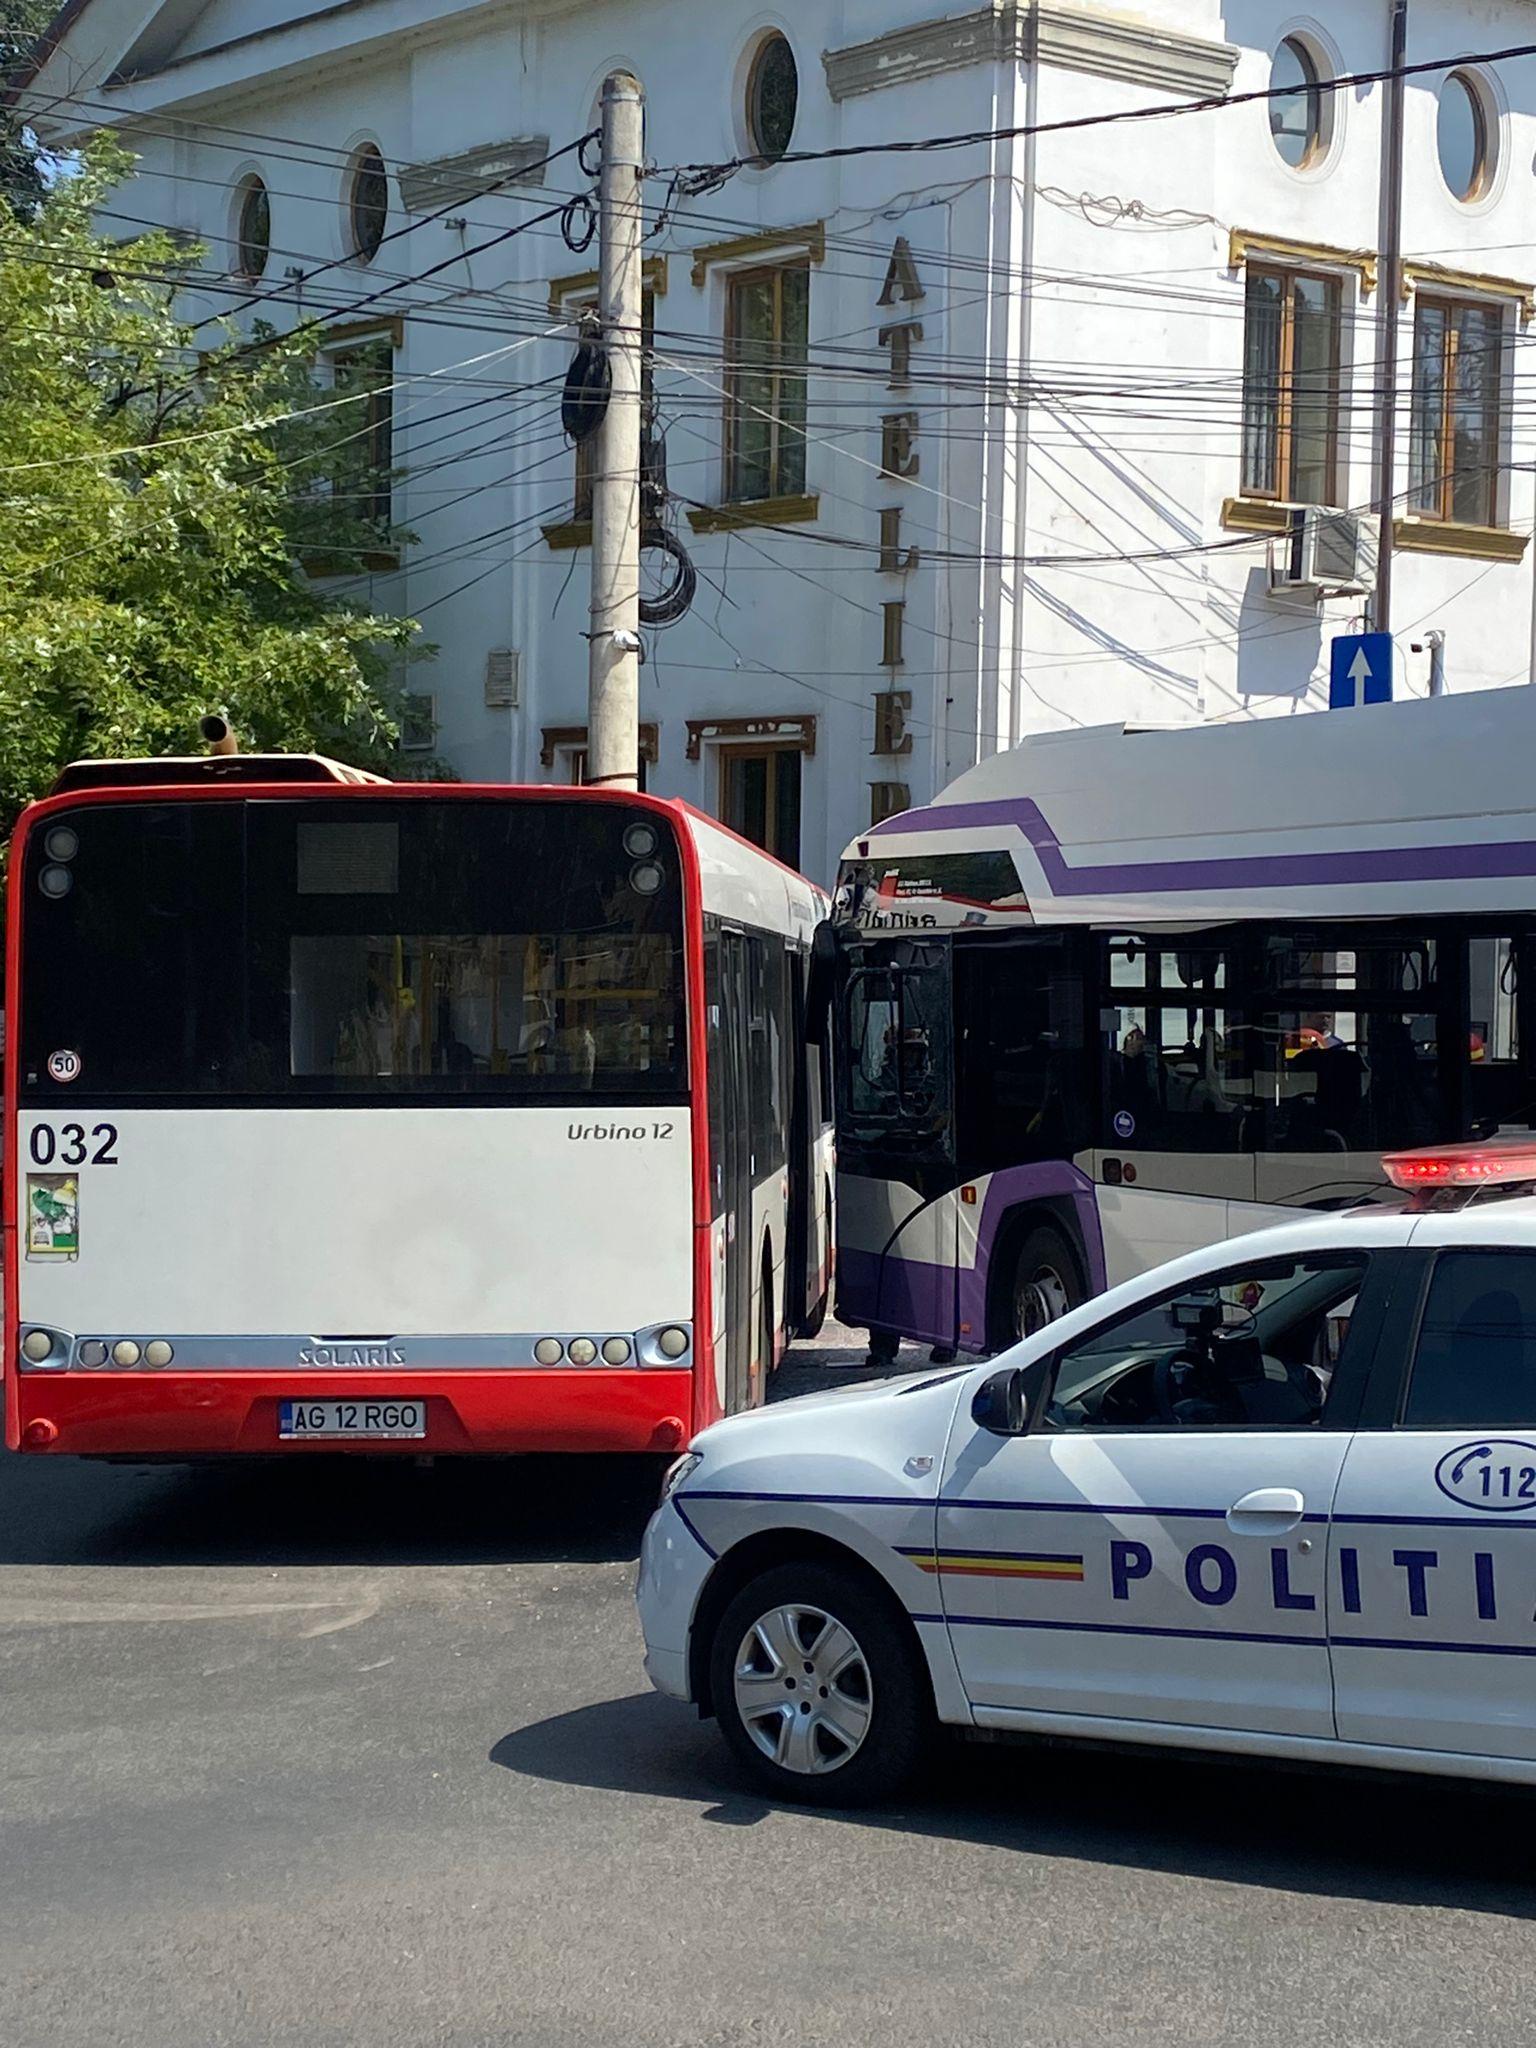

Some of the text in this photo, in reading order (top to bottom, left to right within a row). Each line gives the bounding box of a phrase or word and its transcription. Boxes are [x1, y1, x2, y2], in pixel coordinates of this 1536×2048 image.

[54, 1057, 75, 1073] 50
[30, 1123, 118, 1165] 032
[568, 1123, 674, 1140] Urbino 12
[299, 1347, 406, 1367] SOLARIS
[295, 1405, 417, 1430] AG 12 RGO
[1479, 1465, 1536, 1499] 112
[1110, 1540, 1536, 1622] POLITI
